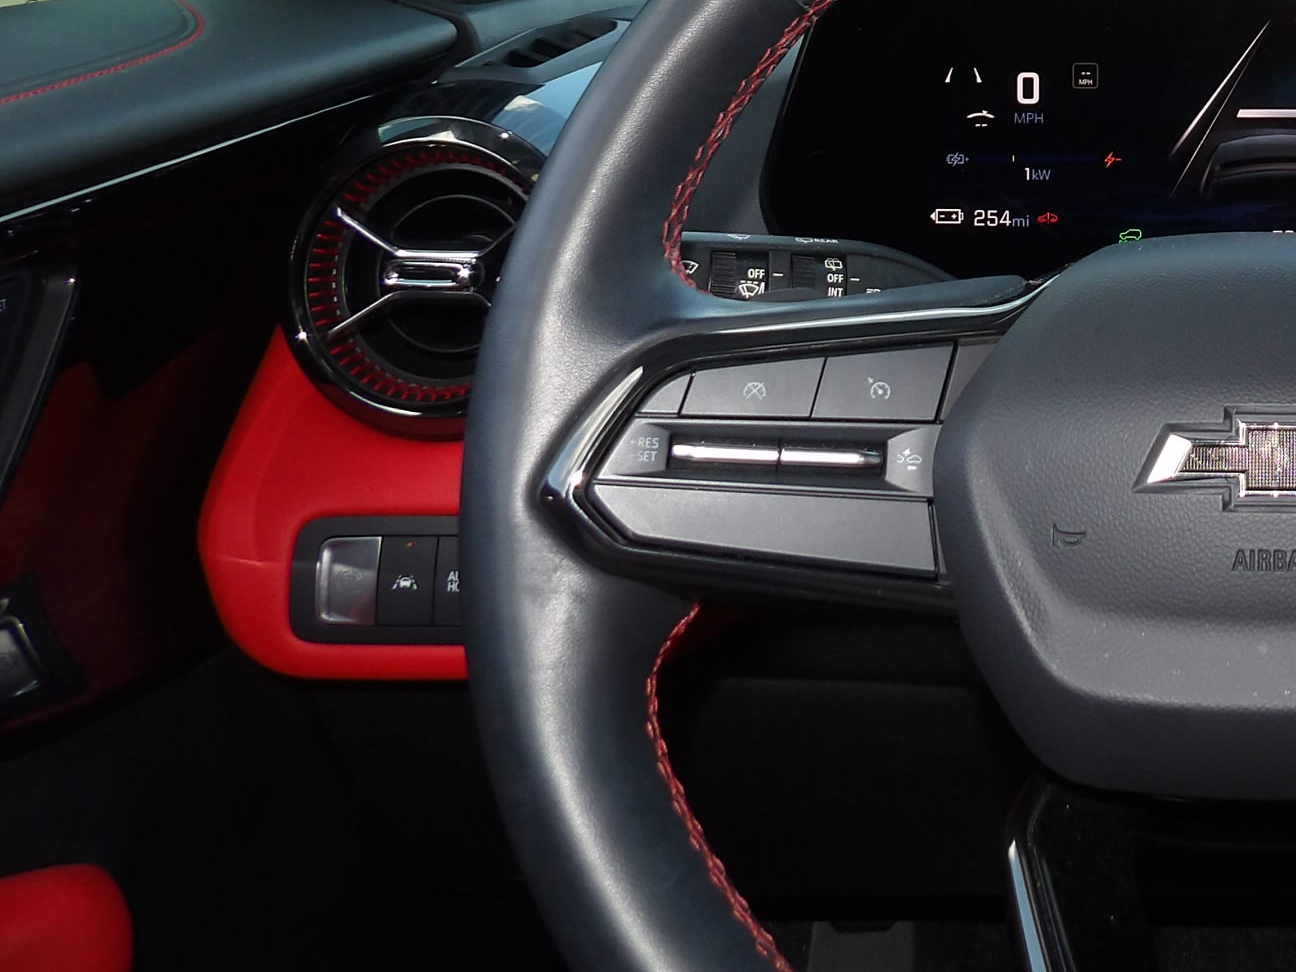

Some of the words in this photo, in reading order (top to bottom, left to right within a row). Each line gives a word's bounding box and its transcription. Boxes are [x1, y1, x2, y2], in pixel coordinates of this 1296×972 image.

[1016, 71, 1040, 105] 0
[1013, 112, 1044, 124] MPH
[747, 268, 766, 279] OFF
[827, 273, 844, 283] OFF
[828, 287, 844, 298] INT
